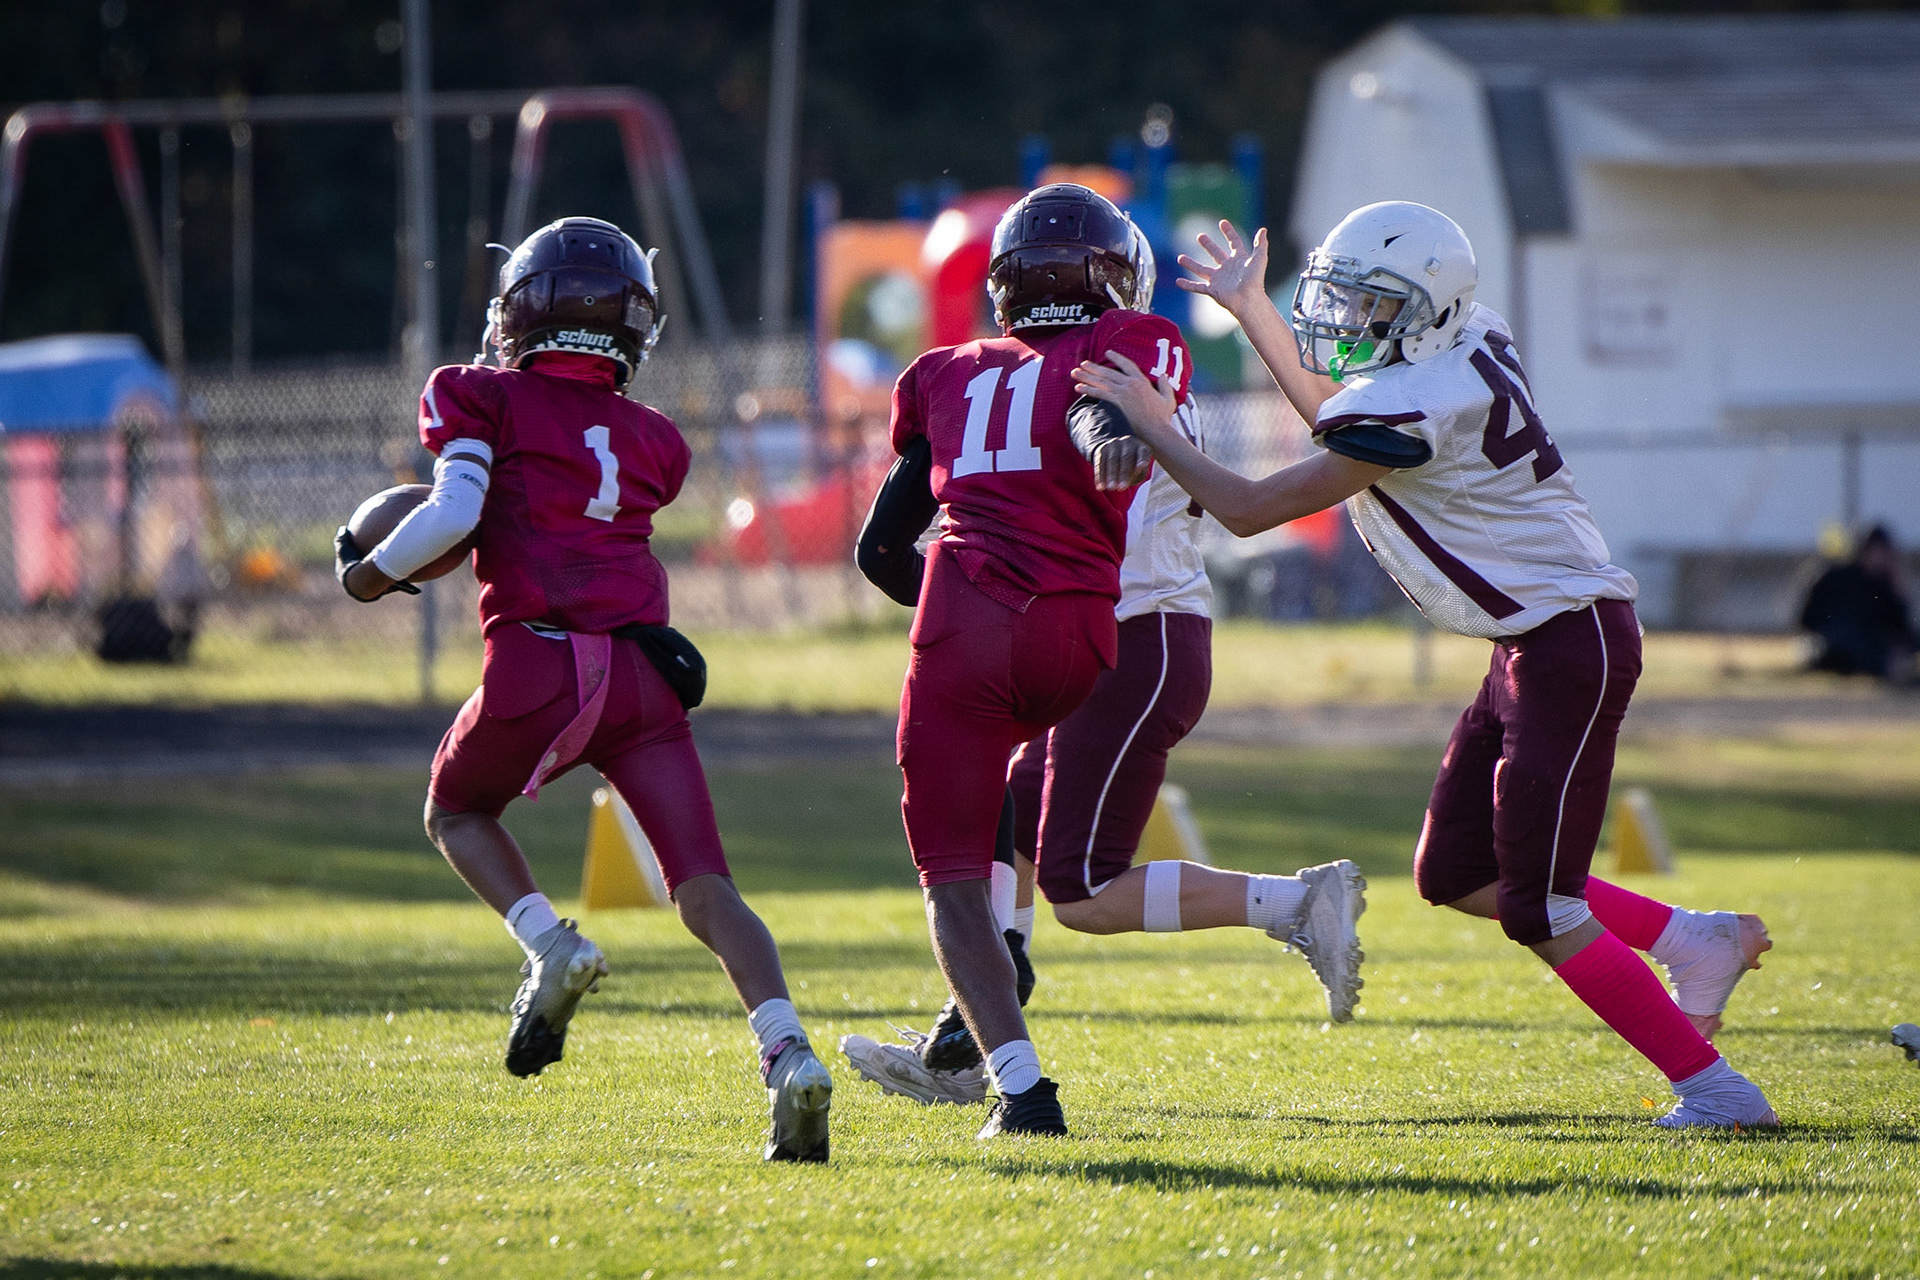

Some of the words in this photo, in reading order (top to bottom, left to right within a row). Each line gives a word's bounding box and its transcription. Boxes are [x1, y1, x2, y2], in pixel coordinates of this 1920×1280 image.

[1030, 303, 1084, 318] schutt
[556, 328, 614, 348] schutt
[1150, 338, 1183, 391] 11
[424, 386, 444, 429] 1
[952, 356, 1043, 479] 11
[584, 425, 622, 522] 1
